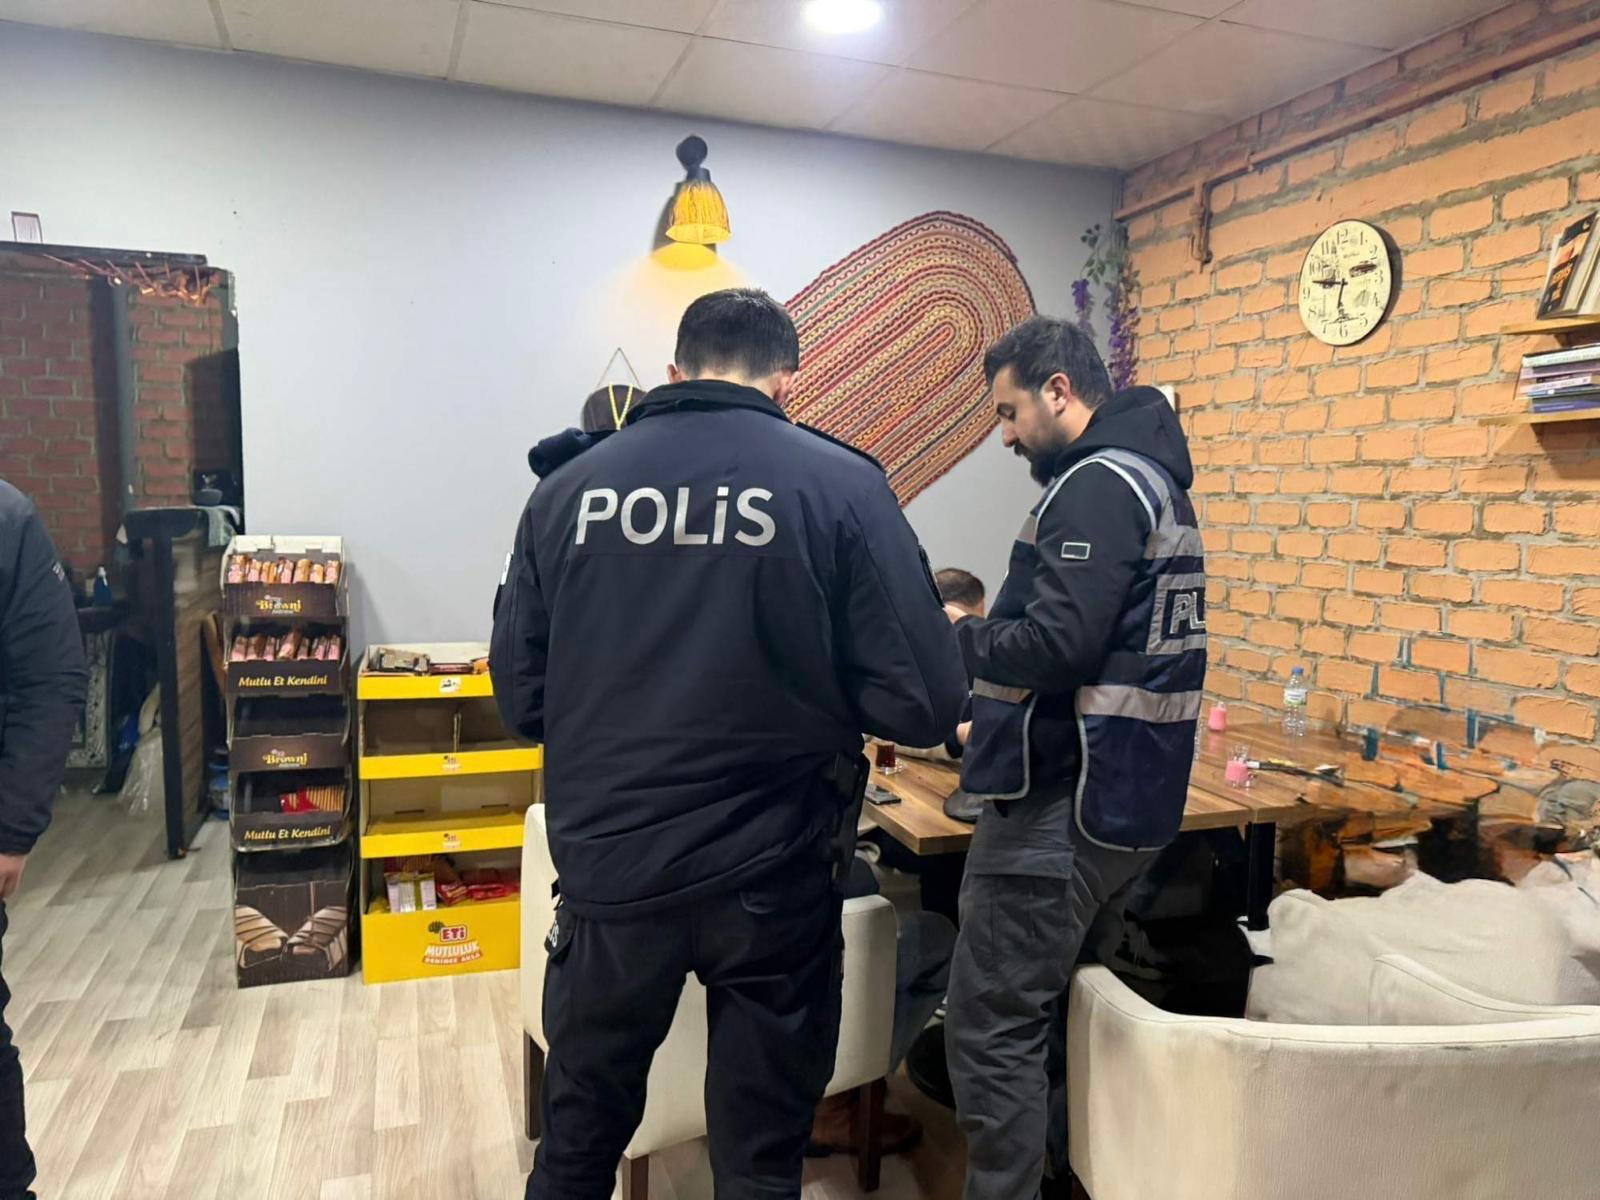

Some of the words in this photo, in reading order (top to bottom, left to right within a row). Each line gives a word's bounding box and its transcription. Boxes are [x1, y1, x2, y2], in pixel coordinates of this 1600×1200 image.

[1336, 228, 1349, 246] 12
[1369, 244, 1378, 260] 2
[1374, 269, 1384, 284] 3
[1302, 286, 1311, 300] 9
[1373, 291, 1381, 308] 4
[1307, 304, 1317, 319] 8
[1321, 319, 1329, 335] 7
[1359, 312, 1369, 328] 5
[1339, 322, 1349, 338] 6
[238, 675, 271, 688] Mutlu
[273, 675, 285, 687] Et
[286, 675, 328, 687] Kendini
[244, 829, 276, 841] Mutlu
[278, 828, 289, 839] Et
[291, 824, 332, 839] Kendini
[425, 939, 481, 958] MUTLULUK
